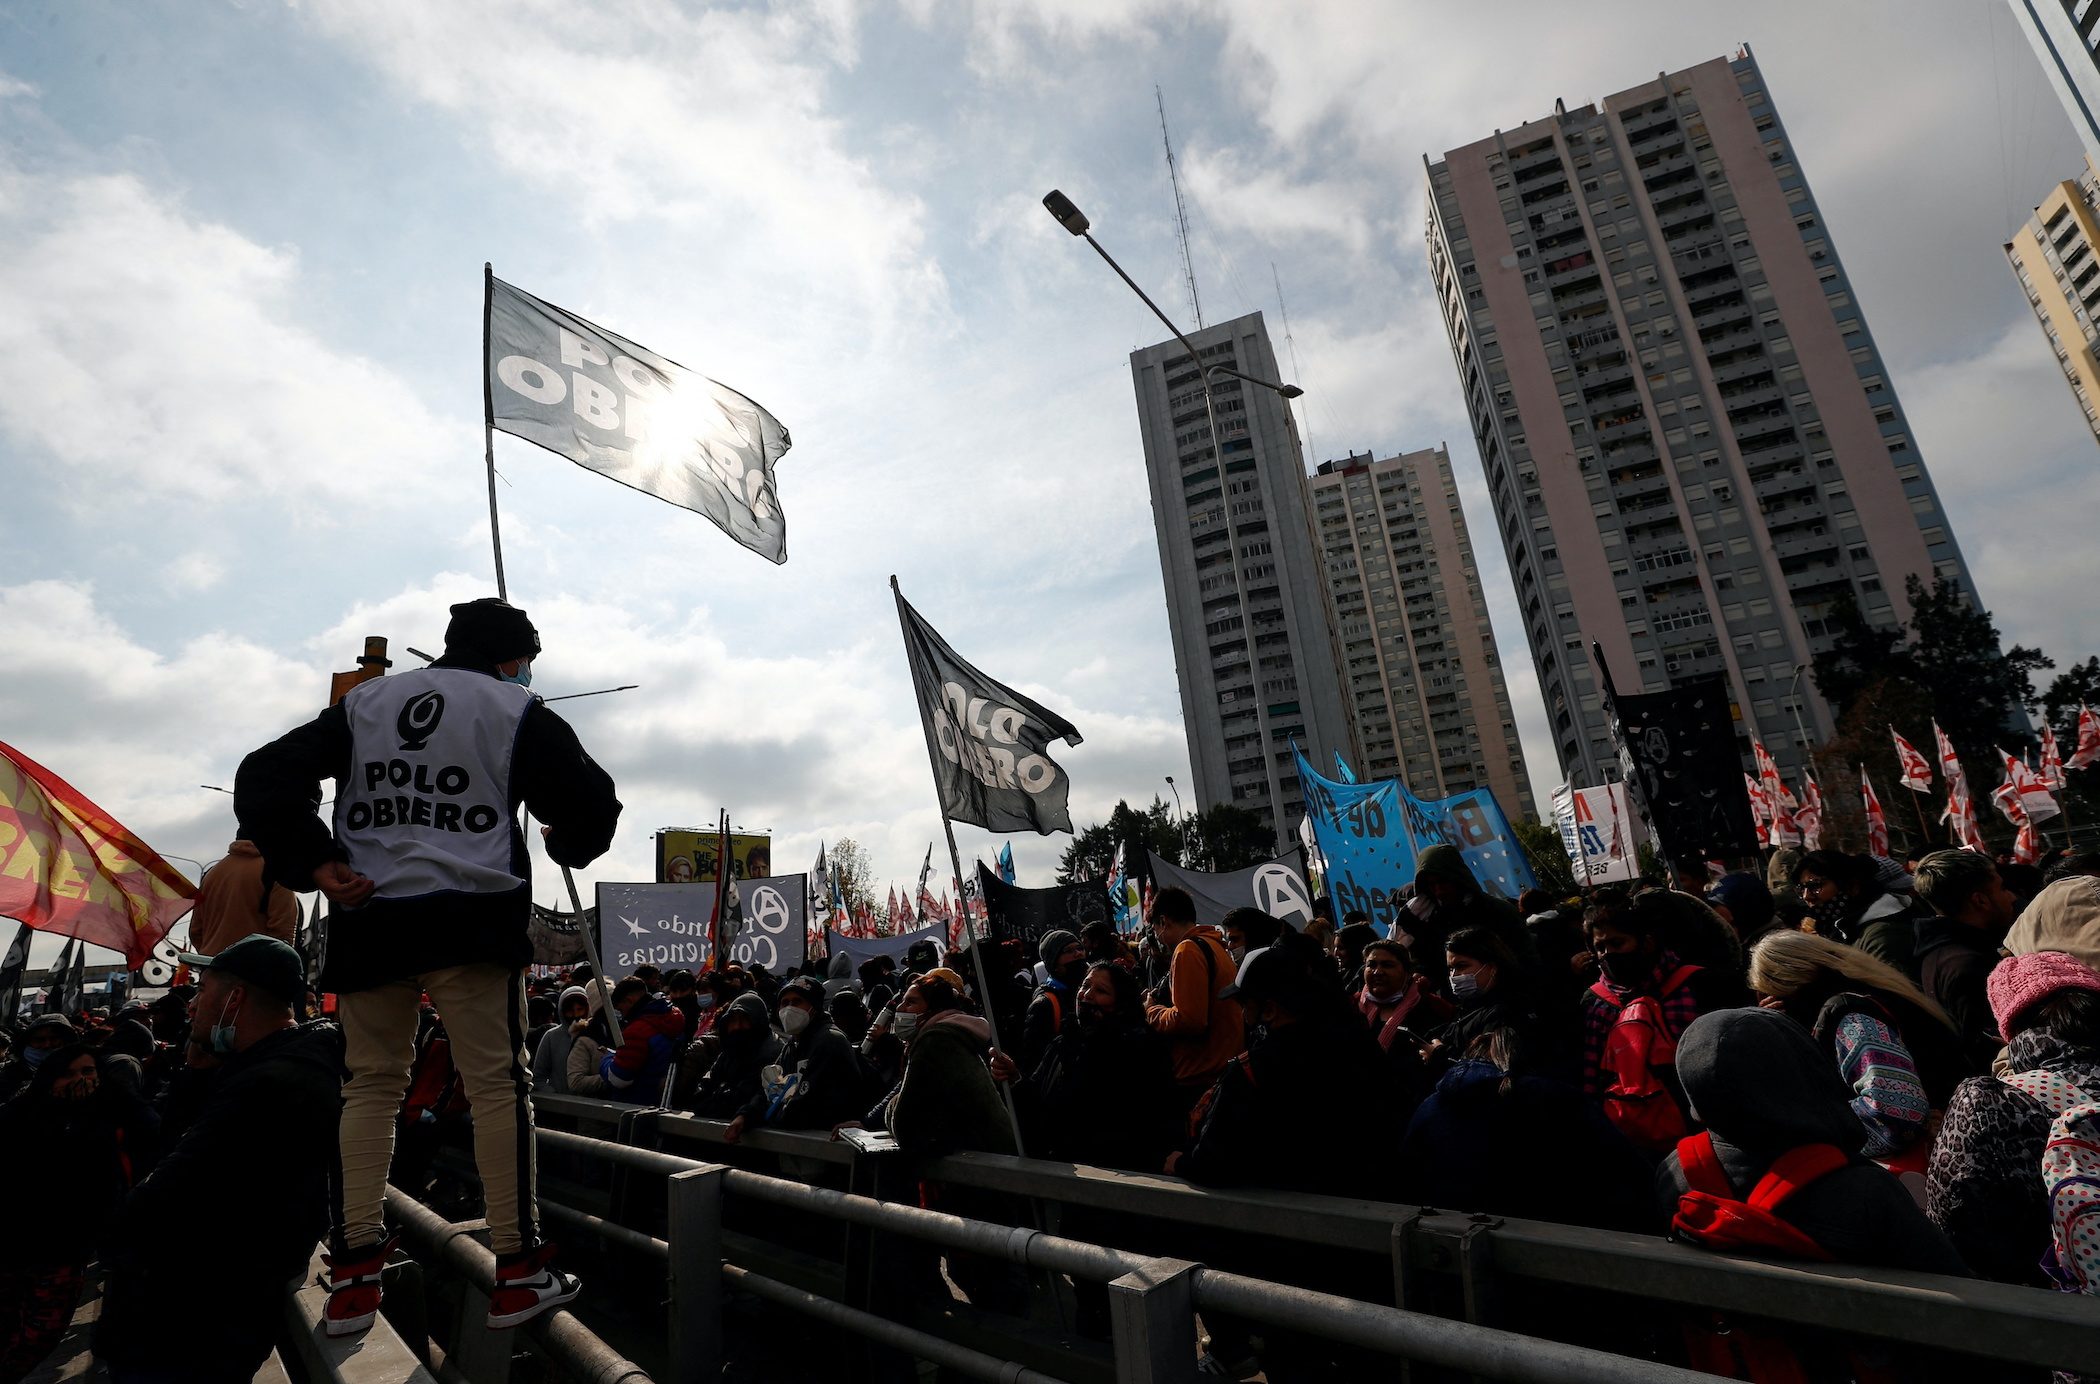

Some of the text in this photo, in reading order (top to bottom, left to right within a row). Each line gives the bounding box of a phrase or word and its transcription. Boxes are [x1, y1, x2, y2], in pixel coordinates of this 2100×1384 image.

[497, 354, 772, 519] OBRO
[365, 758, 470, 796] POLO
[347, 795, 499, 835] OBRERO
